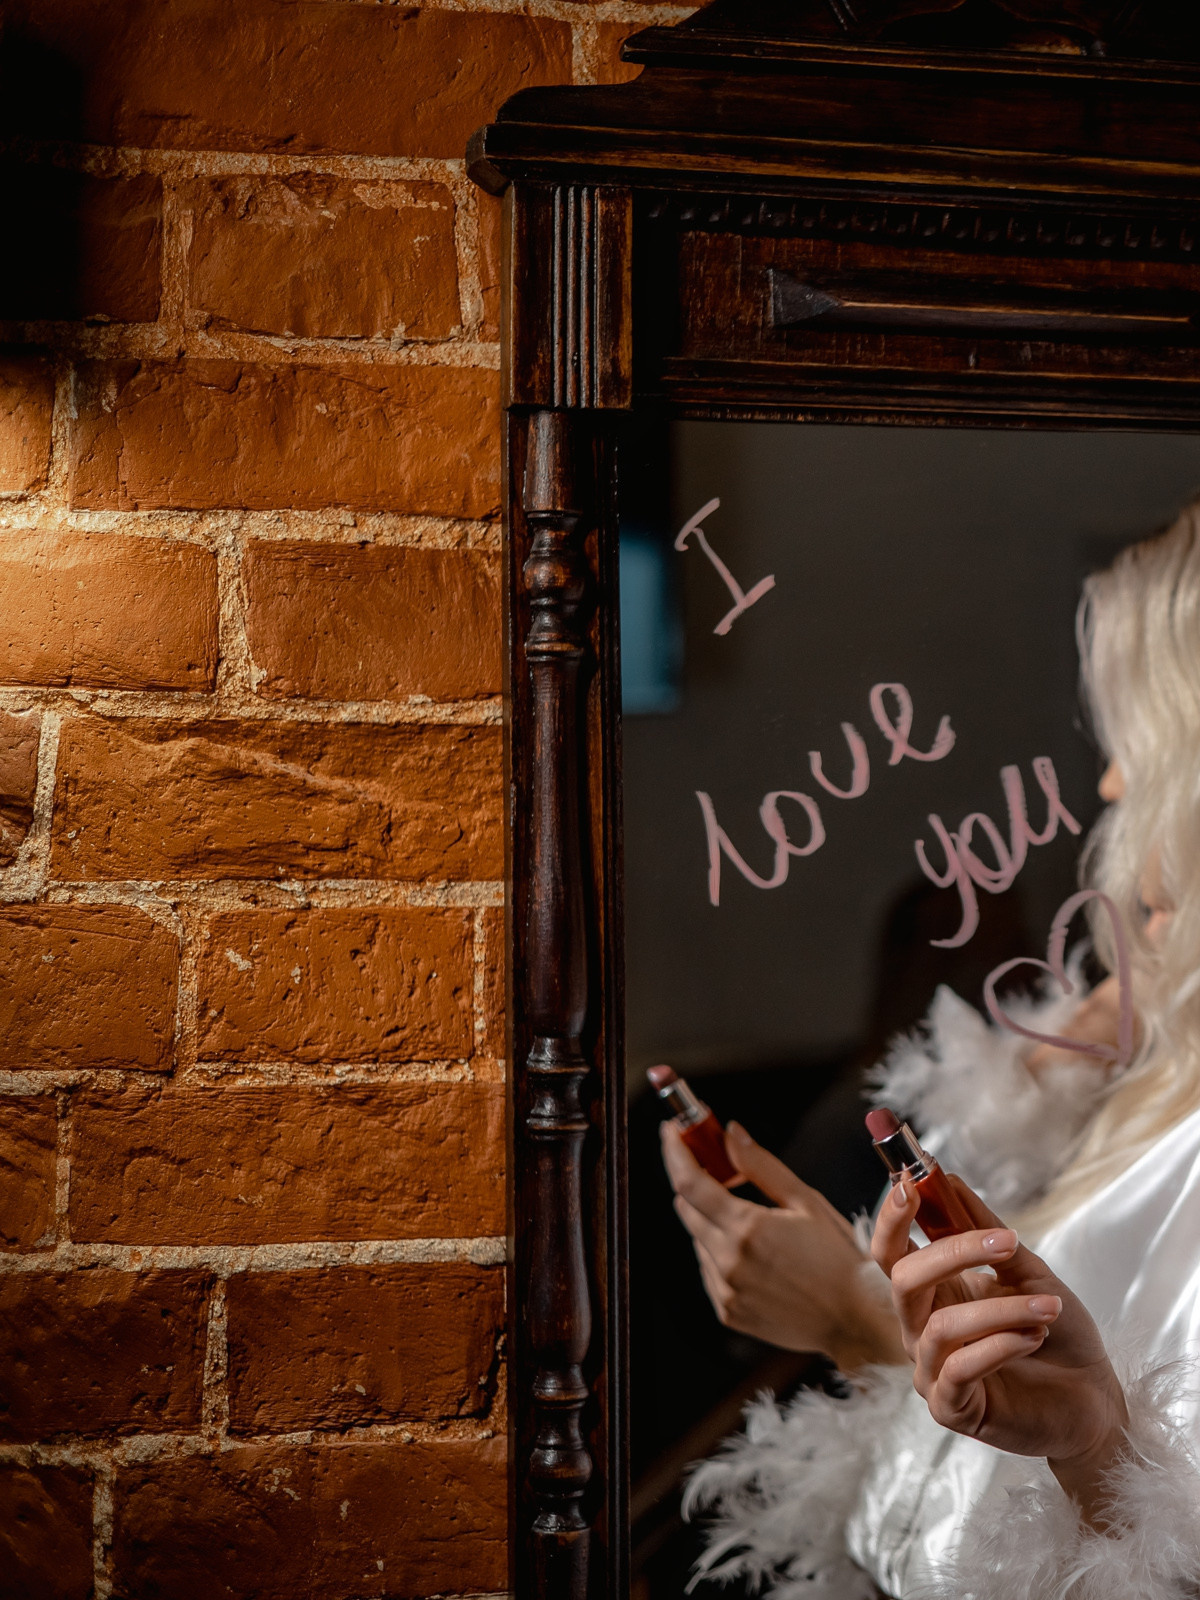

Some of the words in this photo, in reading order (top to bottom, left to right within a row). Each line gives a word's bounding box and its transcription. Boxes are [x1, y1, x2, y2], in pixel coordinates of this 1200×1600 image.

[675, 498, 776, 635] I
[696, 683, 956, 906] love
[915, 756, 1082, 948] you
